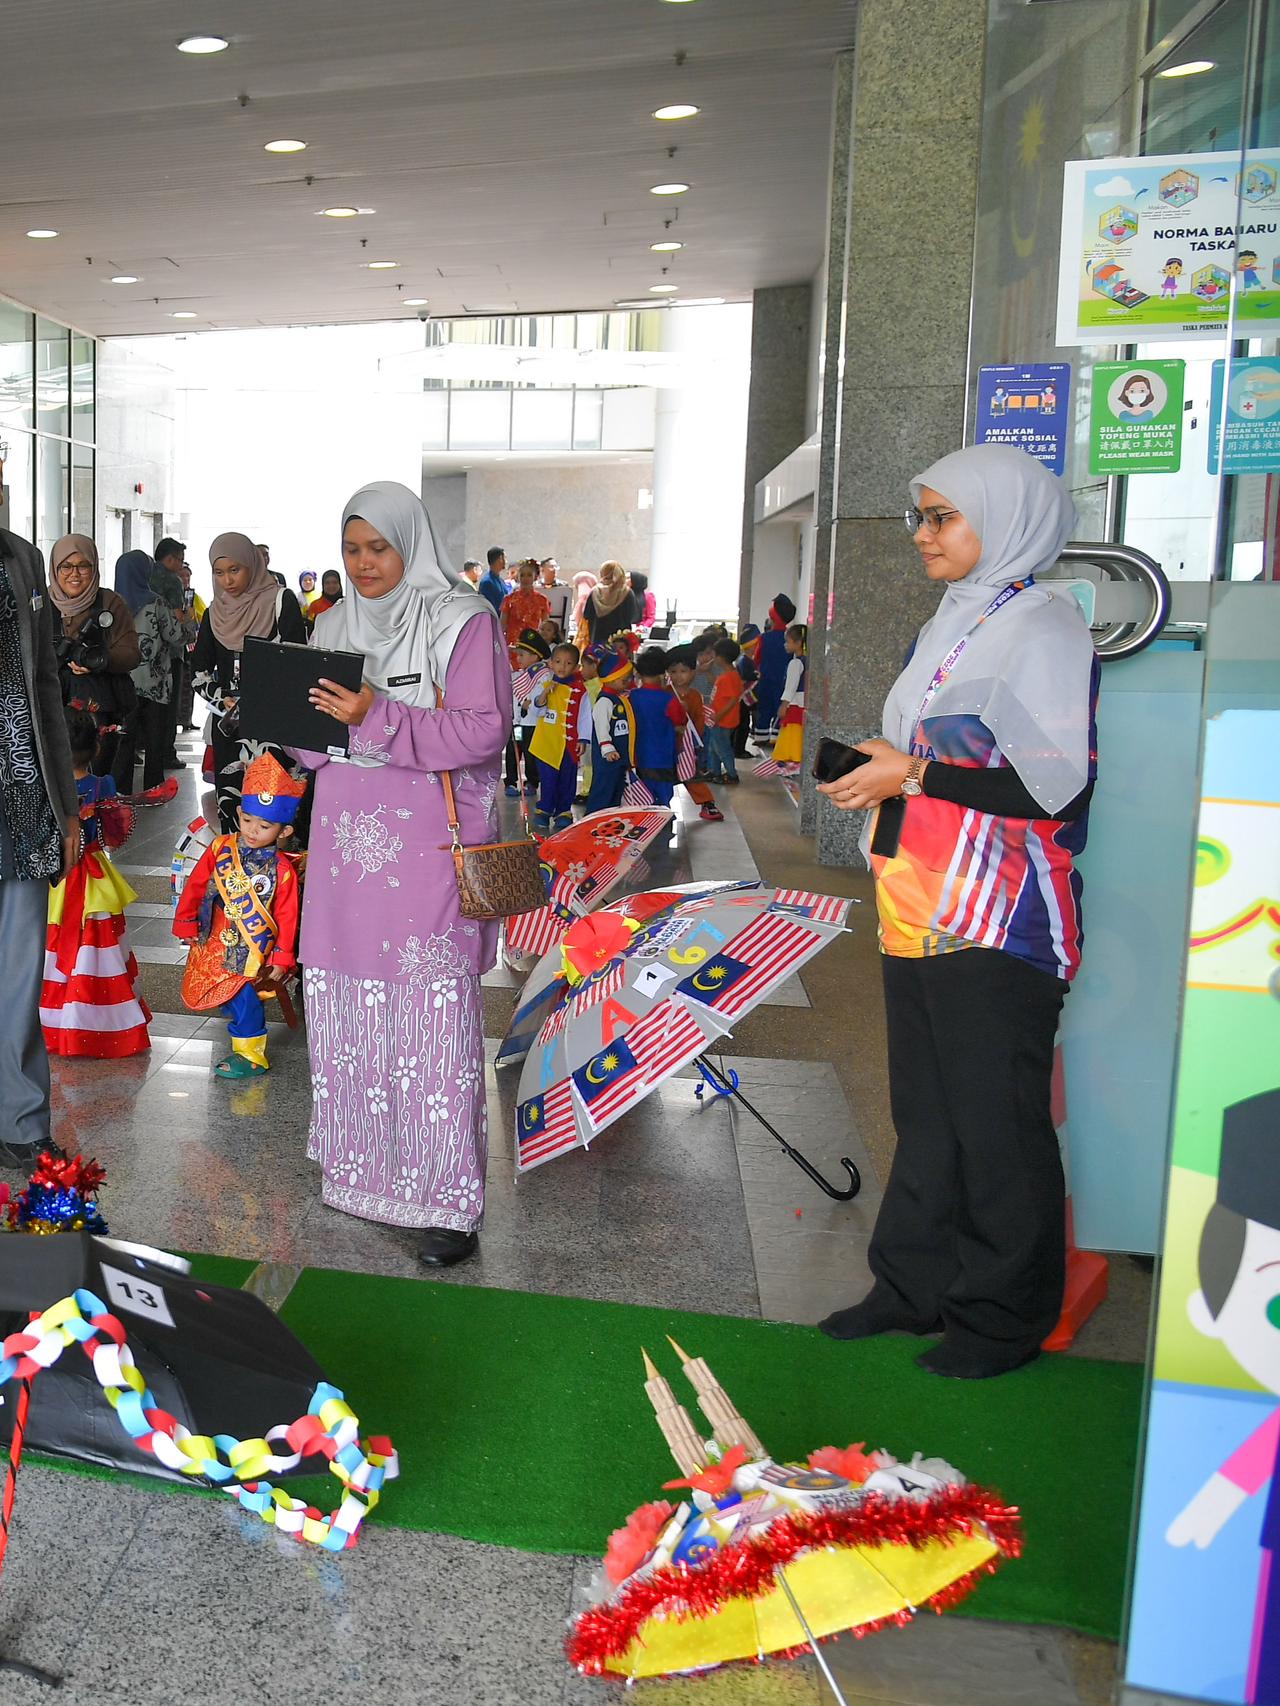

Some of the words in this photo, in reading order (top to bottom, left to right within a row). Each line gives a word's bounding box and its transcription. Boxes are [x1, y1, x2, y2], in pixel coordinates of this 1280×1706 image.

[1153, 227, 1209, 239] NORMA
[1189, 240, 1236, 251] TASKA
[985, 428, 1034, 436] AMALKAN
[1126, 424, 1176, 432] GUNAKAN
[616, 723, 626, 731] 19
[646, 971, 658, 982] 1
[117, 1282, 158, 1308] 13
